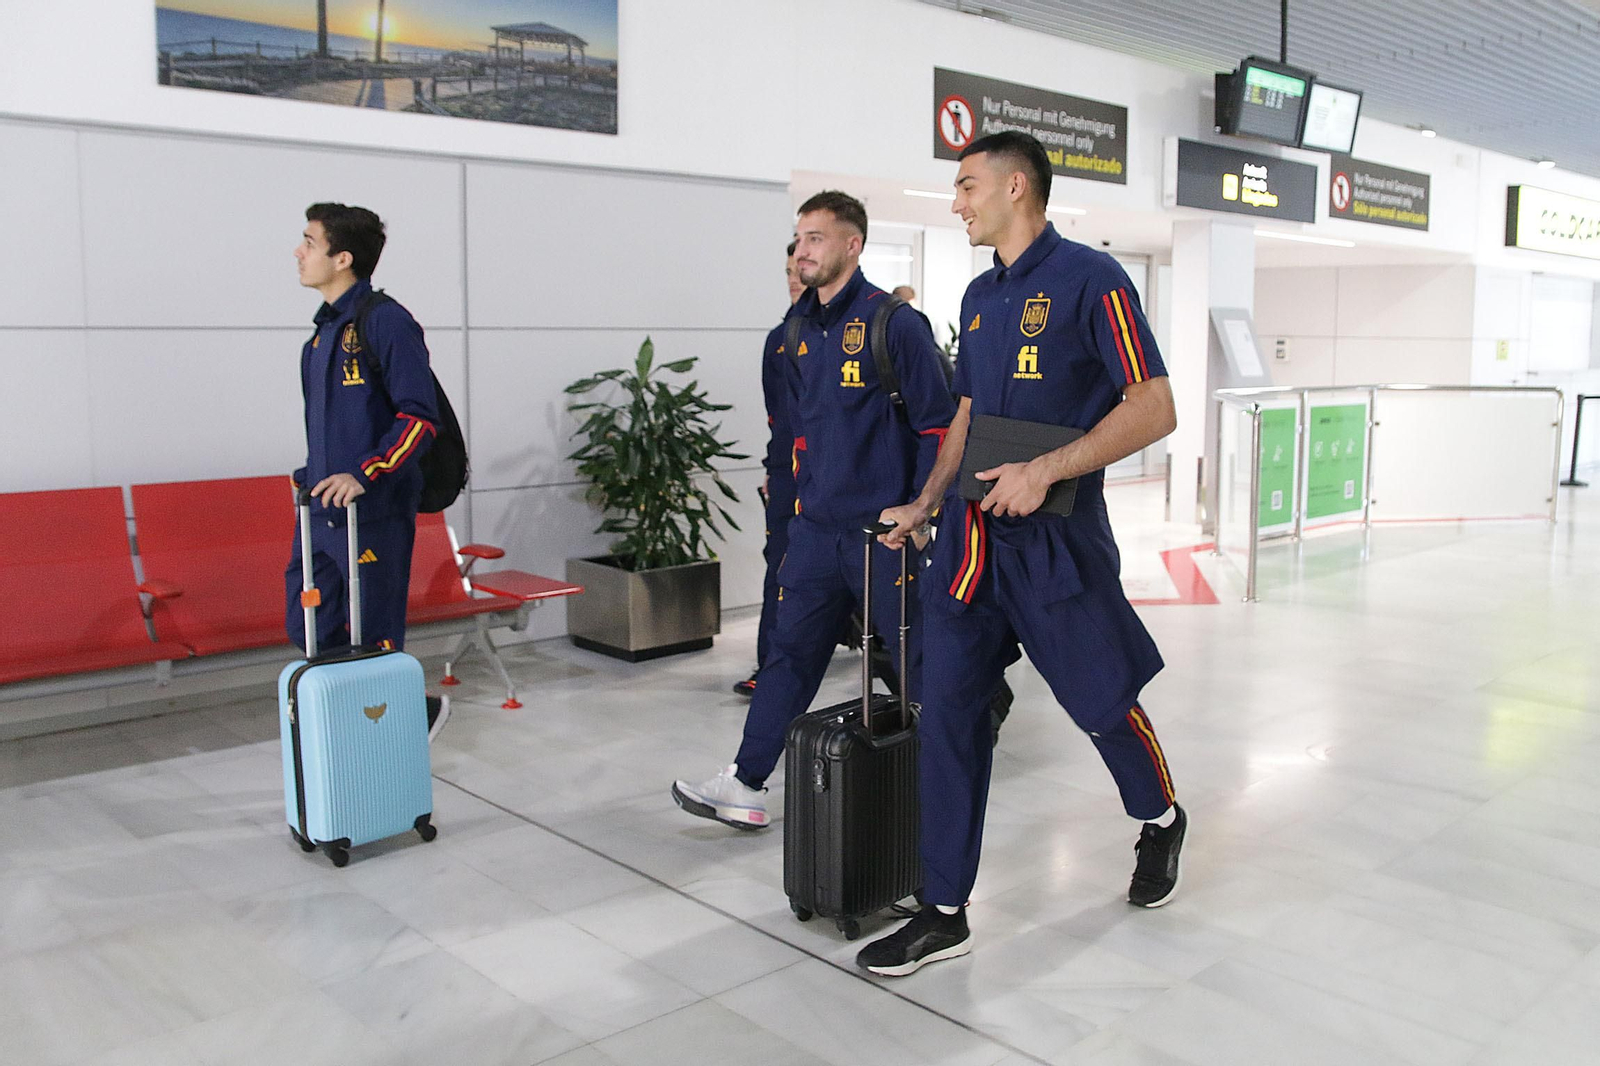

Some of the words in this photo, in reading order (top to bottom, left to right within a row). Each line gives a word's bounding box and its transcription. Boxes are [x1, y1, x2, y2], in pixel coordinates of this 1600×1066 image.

[982, 96, 1001, 115] Nur
[1002, 100, 1041, 122] Personal
[1043, 111, 1058, 125] mit
[1059, 111, 1116, 139] Genehmigung
[1033, 126, 1075, 147] personnel
[1076, 139, 1095, 153] only
[1065, 153, 1122, 174] autorizado
